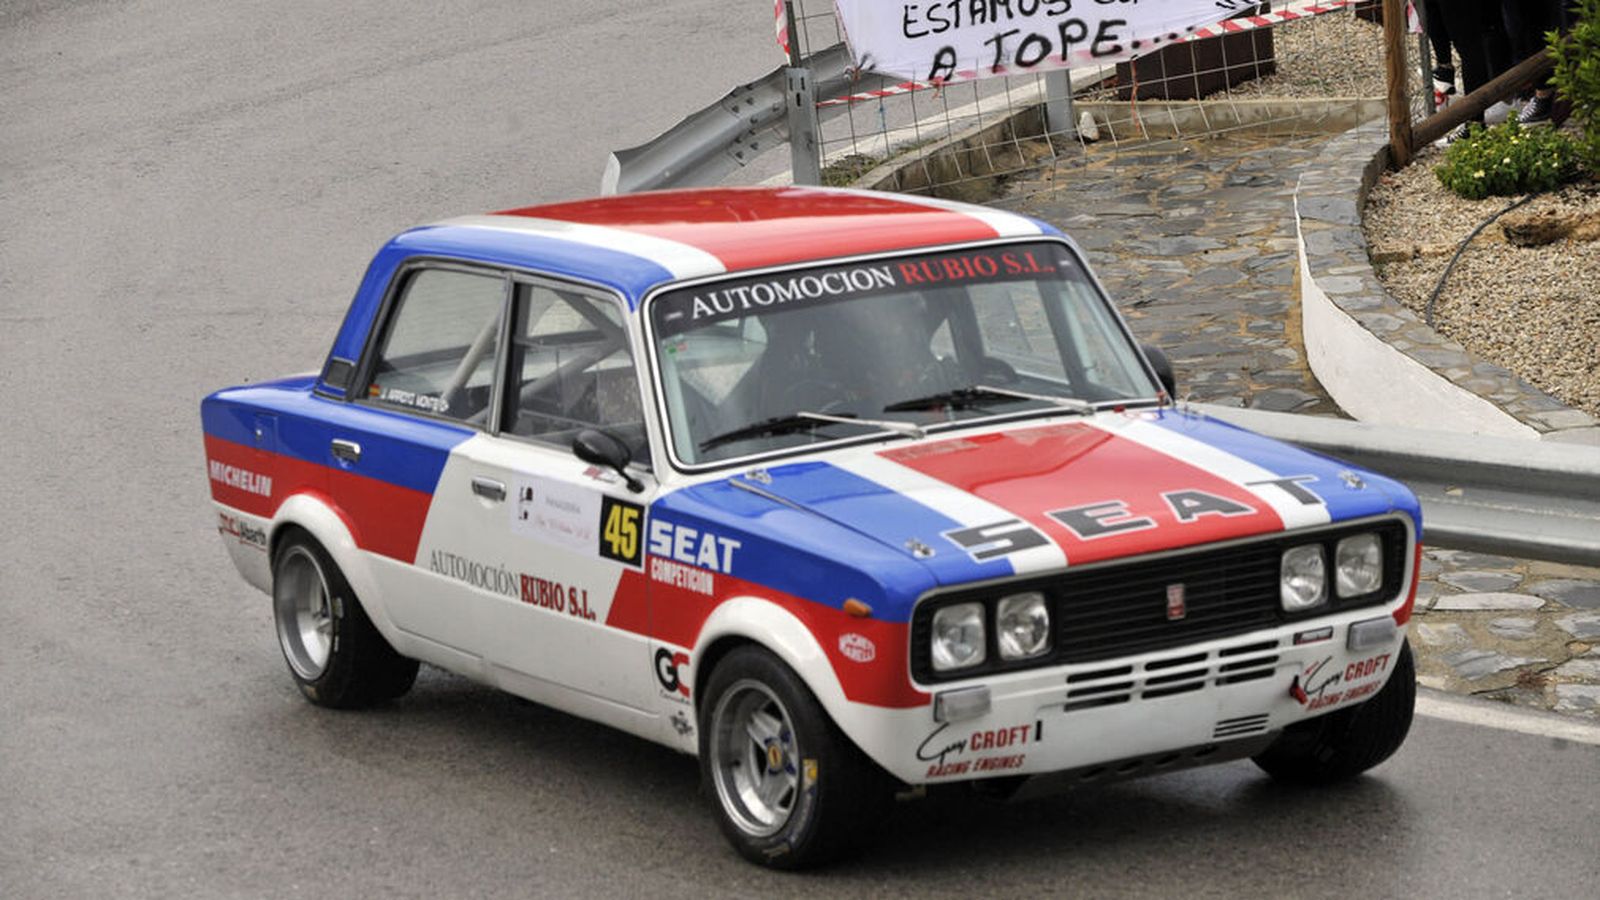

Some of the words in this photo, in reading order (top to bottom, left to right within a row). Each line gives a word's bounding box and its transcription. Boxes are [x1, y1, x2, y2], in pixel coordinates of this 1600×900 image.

[902, 0, 1072, 38] ESTAMOS
[928, 45, 957, 82] A
[691, 265, 897, 320] AUTOMOCION
[898, 254, 998, 285] RUBIO
[1004, 251, 1057, 274] S.L.
[210, 459, 272, 497] MICHELIN
[604, 504, 640, 560] 45
[941, 476, 1329, 563] SEAT
[649, 519, 742, 574] SEAT
[430, 550, 519, 597] AUTOMOCIÓN
[520, 573, 566, 613] RUBIO
[568, 586, 597, 621] S.L.
[654, 647, 691, 698] GC
[1344, 652, 1392, 682] CROFT
[970, 724, 1031, 751] CROFT
[926, 759, 970, 779] RACING
[973, 754, 1026, 773] ENGINES
